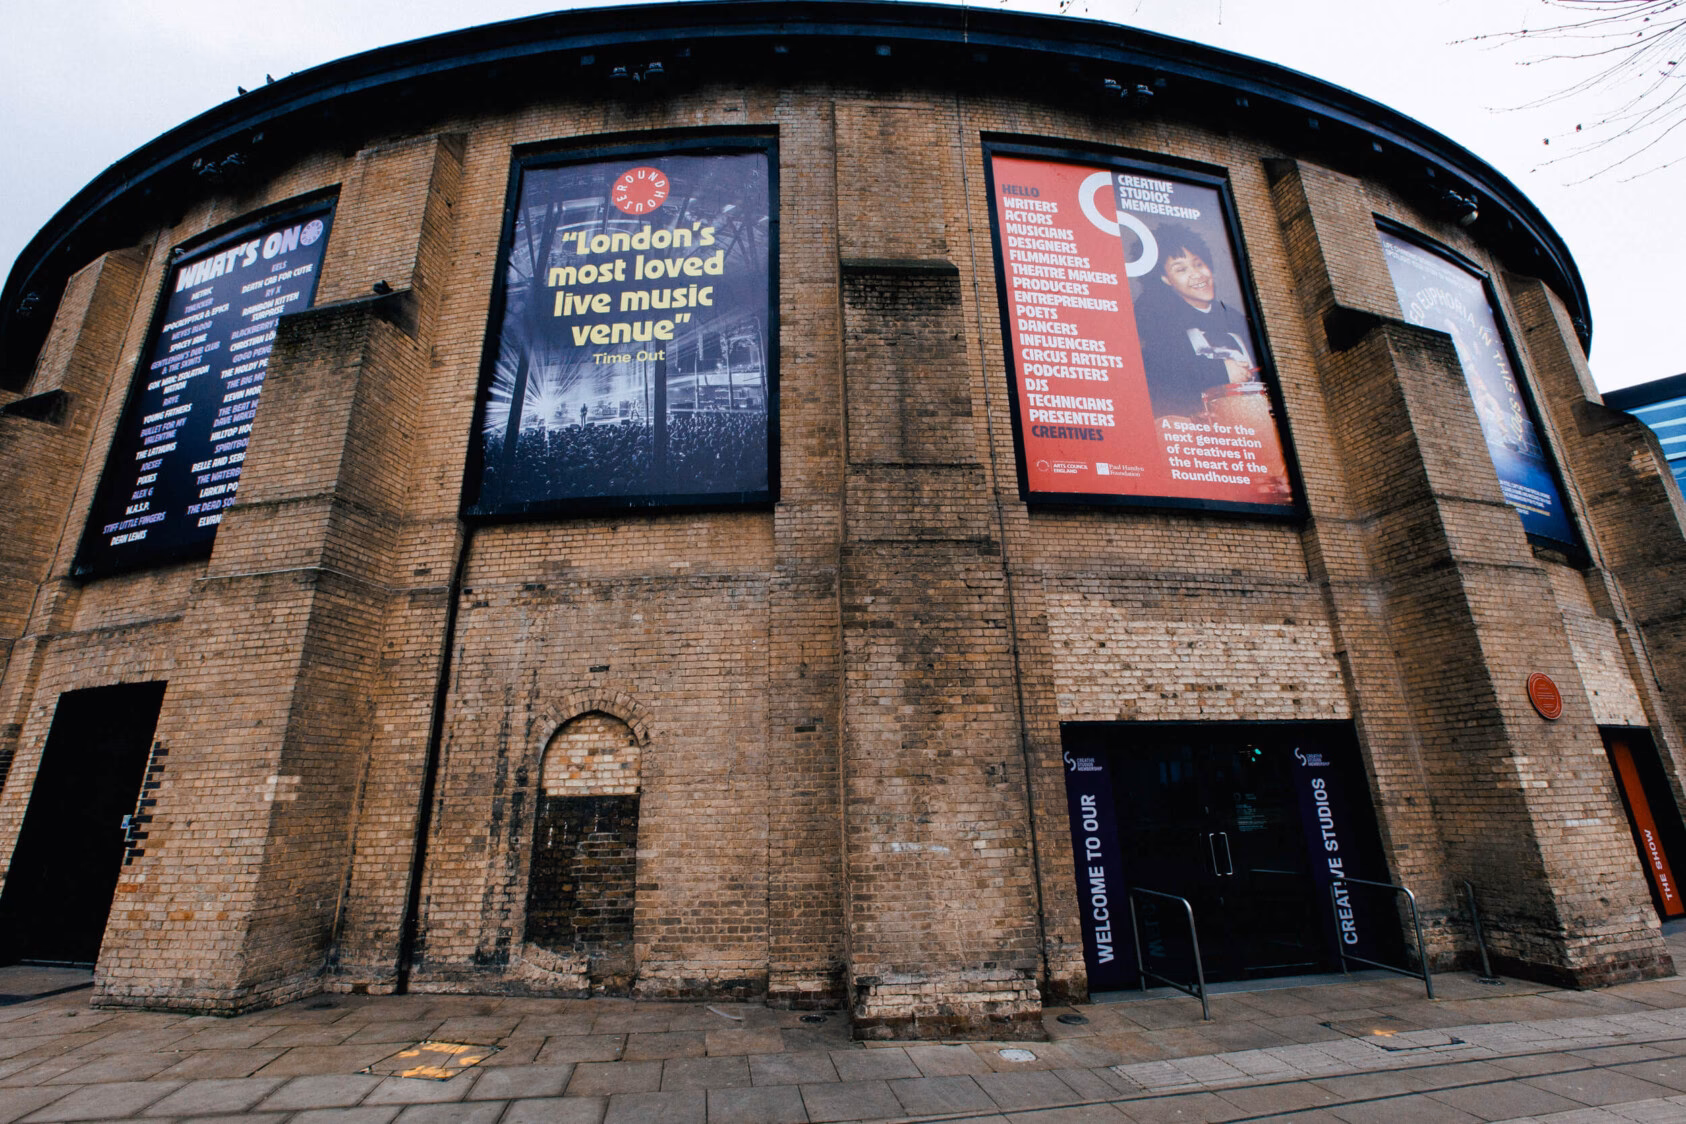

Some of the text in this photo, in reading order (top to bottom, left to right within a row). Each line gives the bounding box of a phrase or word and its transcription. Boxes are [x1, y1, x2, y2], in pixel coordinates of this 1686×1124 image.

[616, 169, 667, 213] ROUNDHOUSE
[1001, 183, 1040, 198] HELLO
[1117, 174, 1174, 194] CREATIVE
[1119, 186, 1170, 204] STUDIOS
[1003, 196, 1058, 214] WRITERS
[1121, 198, 1201, 221] MEMBERSHIP
[1005, 210, 1053, 226] ACTORS
[561, 221, 716, 255] "London's
[1006, 222, 1074, 241] MUSICIANS
[1008, 236, 1078, 255] DESIGNERS
[175, 224, 302, 293] WHAT'S ON
[1009, 249, 1090, 269] FILMMAKERS
[547, 249, 725, 287] most loved
[1011, 262, 1118, 285] THEATRE MAKERS
[241, 263, 314, 294] DEATH CAB FOR CUTIE
[1012, 276, 1090, 296] PRODUCERS
[241, 290, 300, 317] RAINBOW KITTEN
[553, 283, 713, 317] live music
[1014, 290, 1119, 312] ENTREPRENEURS
[250, 304, 285, 322] SURPRISE
[1016, 304, 1058, 320] POETS
[231, 320, 275, 340] BLACKBERRY
[571, 312, 691, 346] venue"
[1017, 318, 1078, 336] DANCERS
[204, 340, 221, 352] CLUB
[229, 334, 265, 352] CHRISTIAN
[1019, 333, 1106, 353] INFLUENCERS
[1416, 287, 1476, 328] EUPHORIA
[1478, 325, 1492, 347] IN
[1492, 352, 1516, 394] THIS
[232, 349, 252, 364] GOGO
[592, 349, 665, 365] Time Out
[1021, 348, 1124, 369] CIRCUS ARTISTS
[168, 362, 181, 373] THE
[220, 367, 235, 380] THE
[234, 360, 259, 376] MOLDY
[1023, 363, 1109, 382] PODCASTERS
[226, 378, 241, 390] THE
[240, 374, 254, 386] BIG
[1025, 377, 1049, 392] DJS
[223, 389, 245, 404] KEVIN
[1027, 393, 1115, 412] TECHNICIANS
[143, 402, 193, 425] YOUNG FATHERS
[218, 406, 232, 418] THE
[231, 401, 250, 414] BEAT
[1028, 408, 1115, 427] PRESENTERS
[161, 420, 175, 432] FOR
[213, 414, 232, 428] DAVE
[1161, 419, 1255, 436] A space for the
[210, 426, 239, 442] HILLTOP
[1031, 425, 1104, 441] CREATIVES
[1164, 432, 1262, 449] next generation
[135, 450, 149, 461] THE
[1166, 444, 1256, 460] of creatives in
[191, 459, 212, 473] BELLE
[211, 455, 228, 468] AND
[1168, 456, 1268, 474] the heart of the
[136, 472, 158, 486] PIXIES
[196, 473, 212, 486] THE
[1171, 469, 1251, 485] Roundhouse
[131, 488, 148, 500] ALEX
[199, 484, 227, 499] LARKIN
[187, 503, 202, 516] THE
[201, 499, 222, 512] DEAD
[118, 517, 139, 531] LITTLE
[138, 511, 167, 526] FINGERS
[110, 529, 148, 546] DEAN LEWIS
[1311, 777, 1339, 853] STUDIOS
[1644, 829, 1672, 901] THE SHOW
[1080, 793, 1115, 965] WELCOME TO OUR
[1327, 857, 1359, 945] CREATIVE
